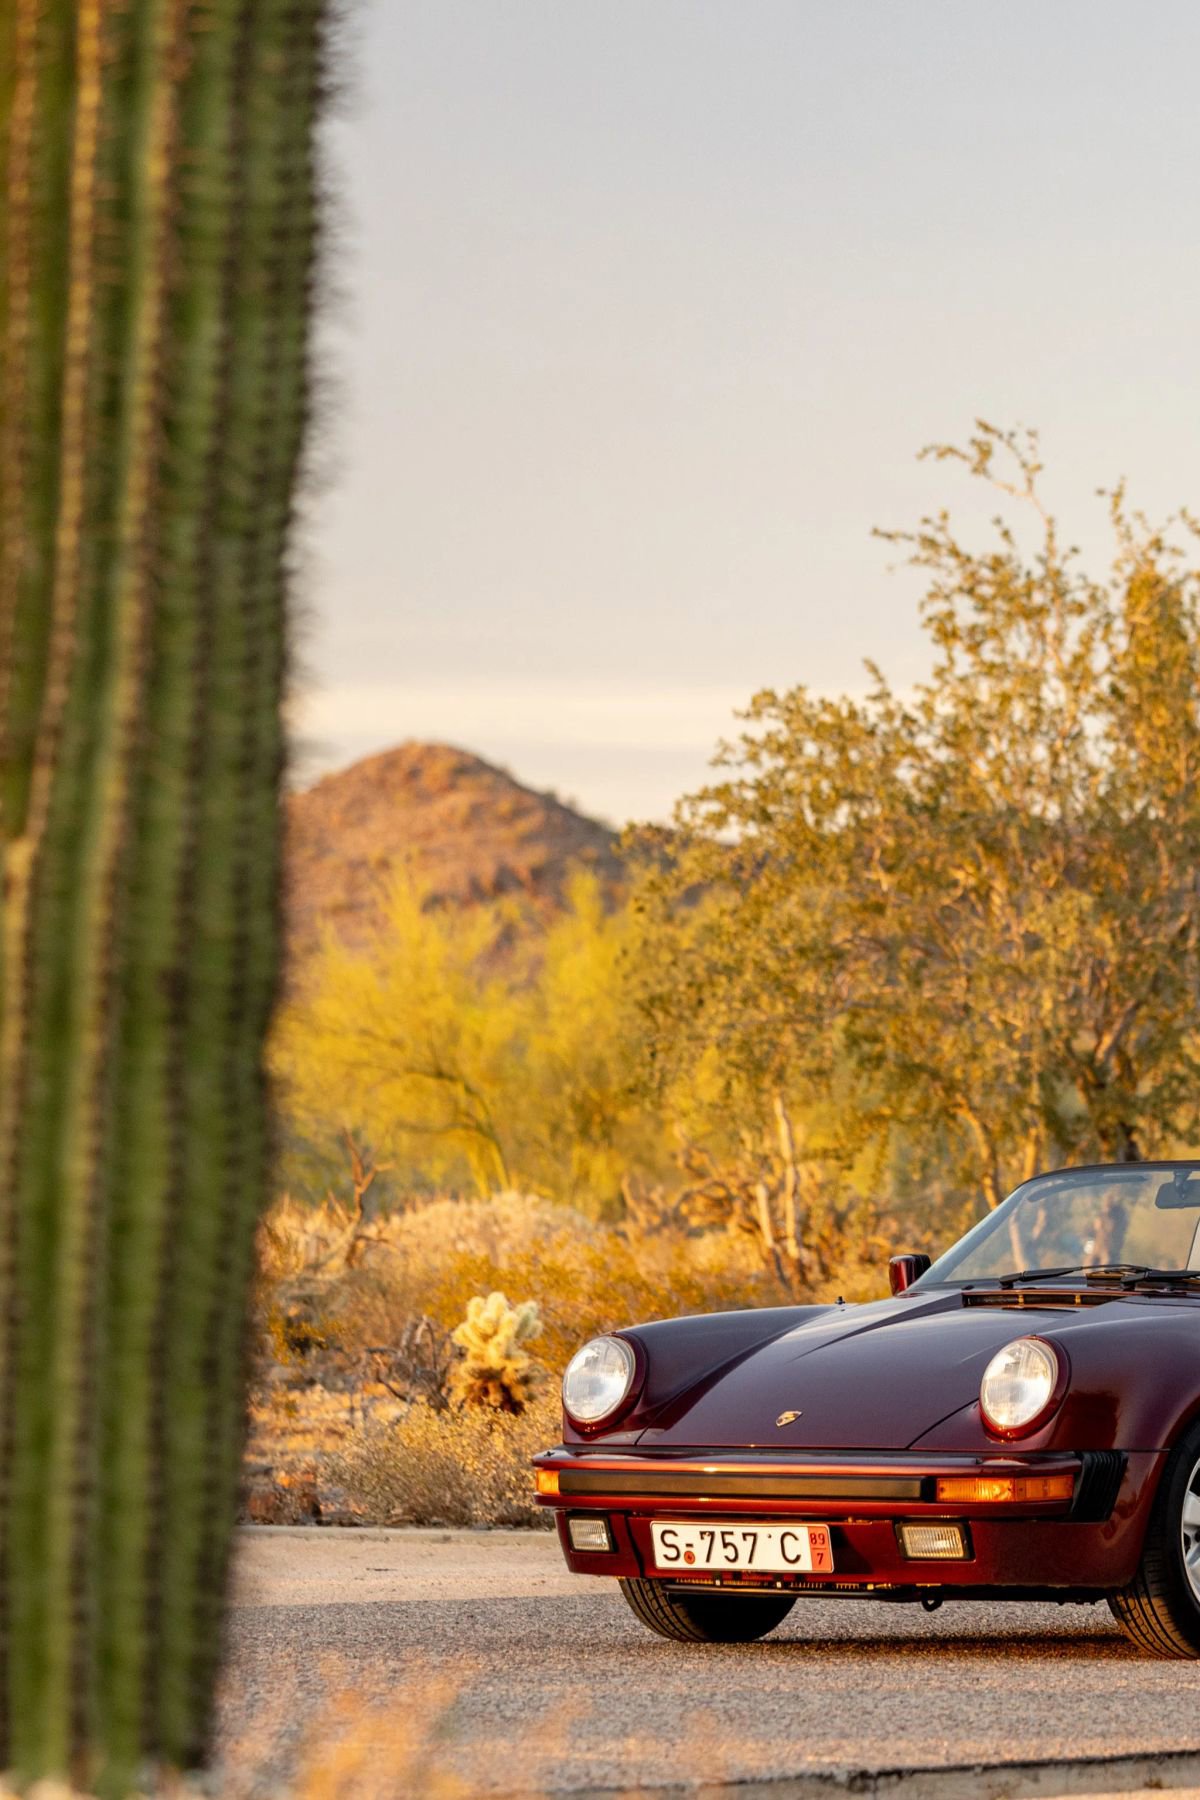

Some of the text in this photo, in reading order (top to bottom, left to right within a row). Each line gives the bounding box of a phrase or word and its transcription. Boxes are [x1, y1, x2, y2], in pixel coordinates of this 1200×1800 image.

[810, 1532, 825, 1545] 89
[780, 1531, 801, 1564] C
[817, 1552, 824, 1565] 7
